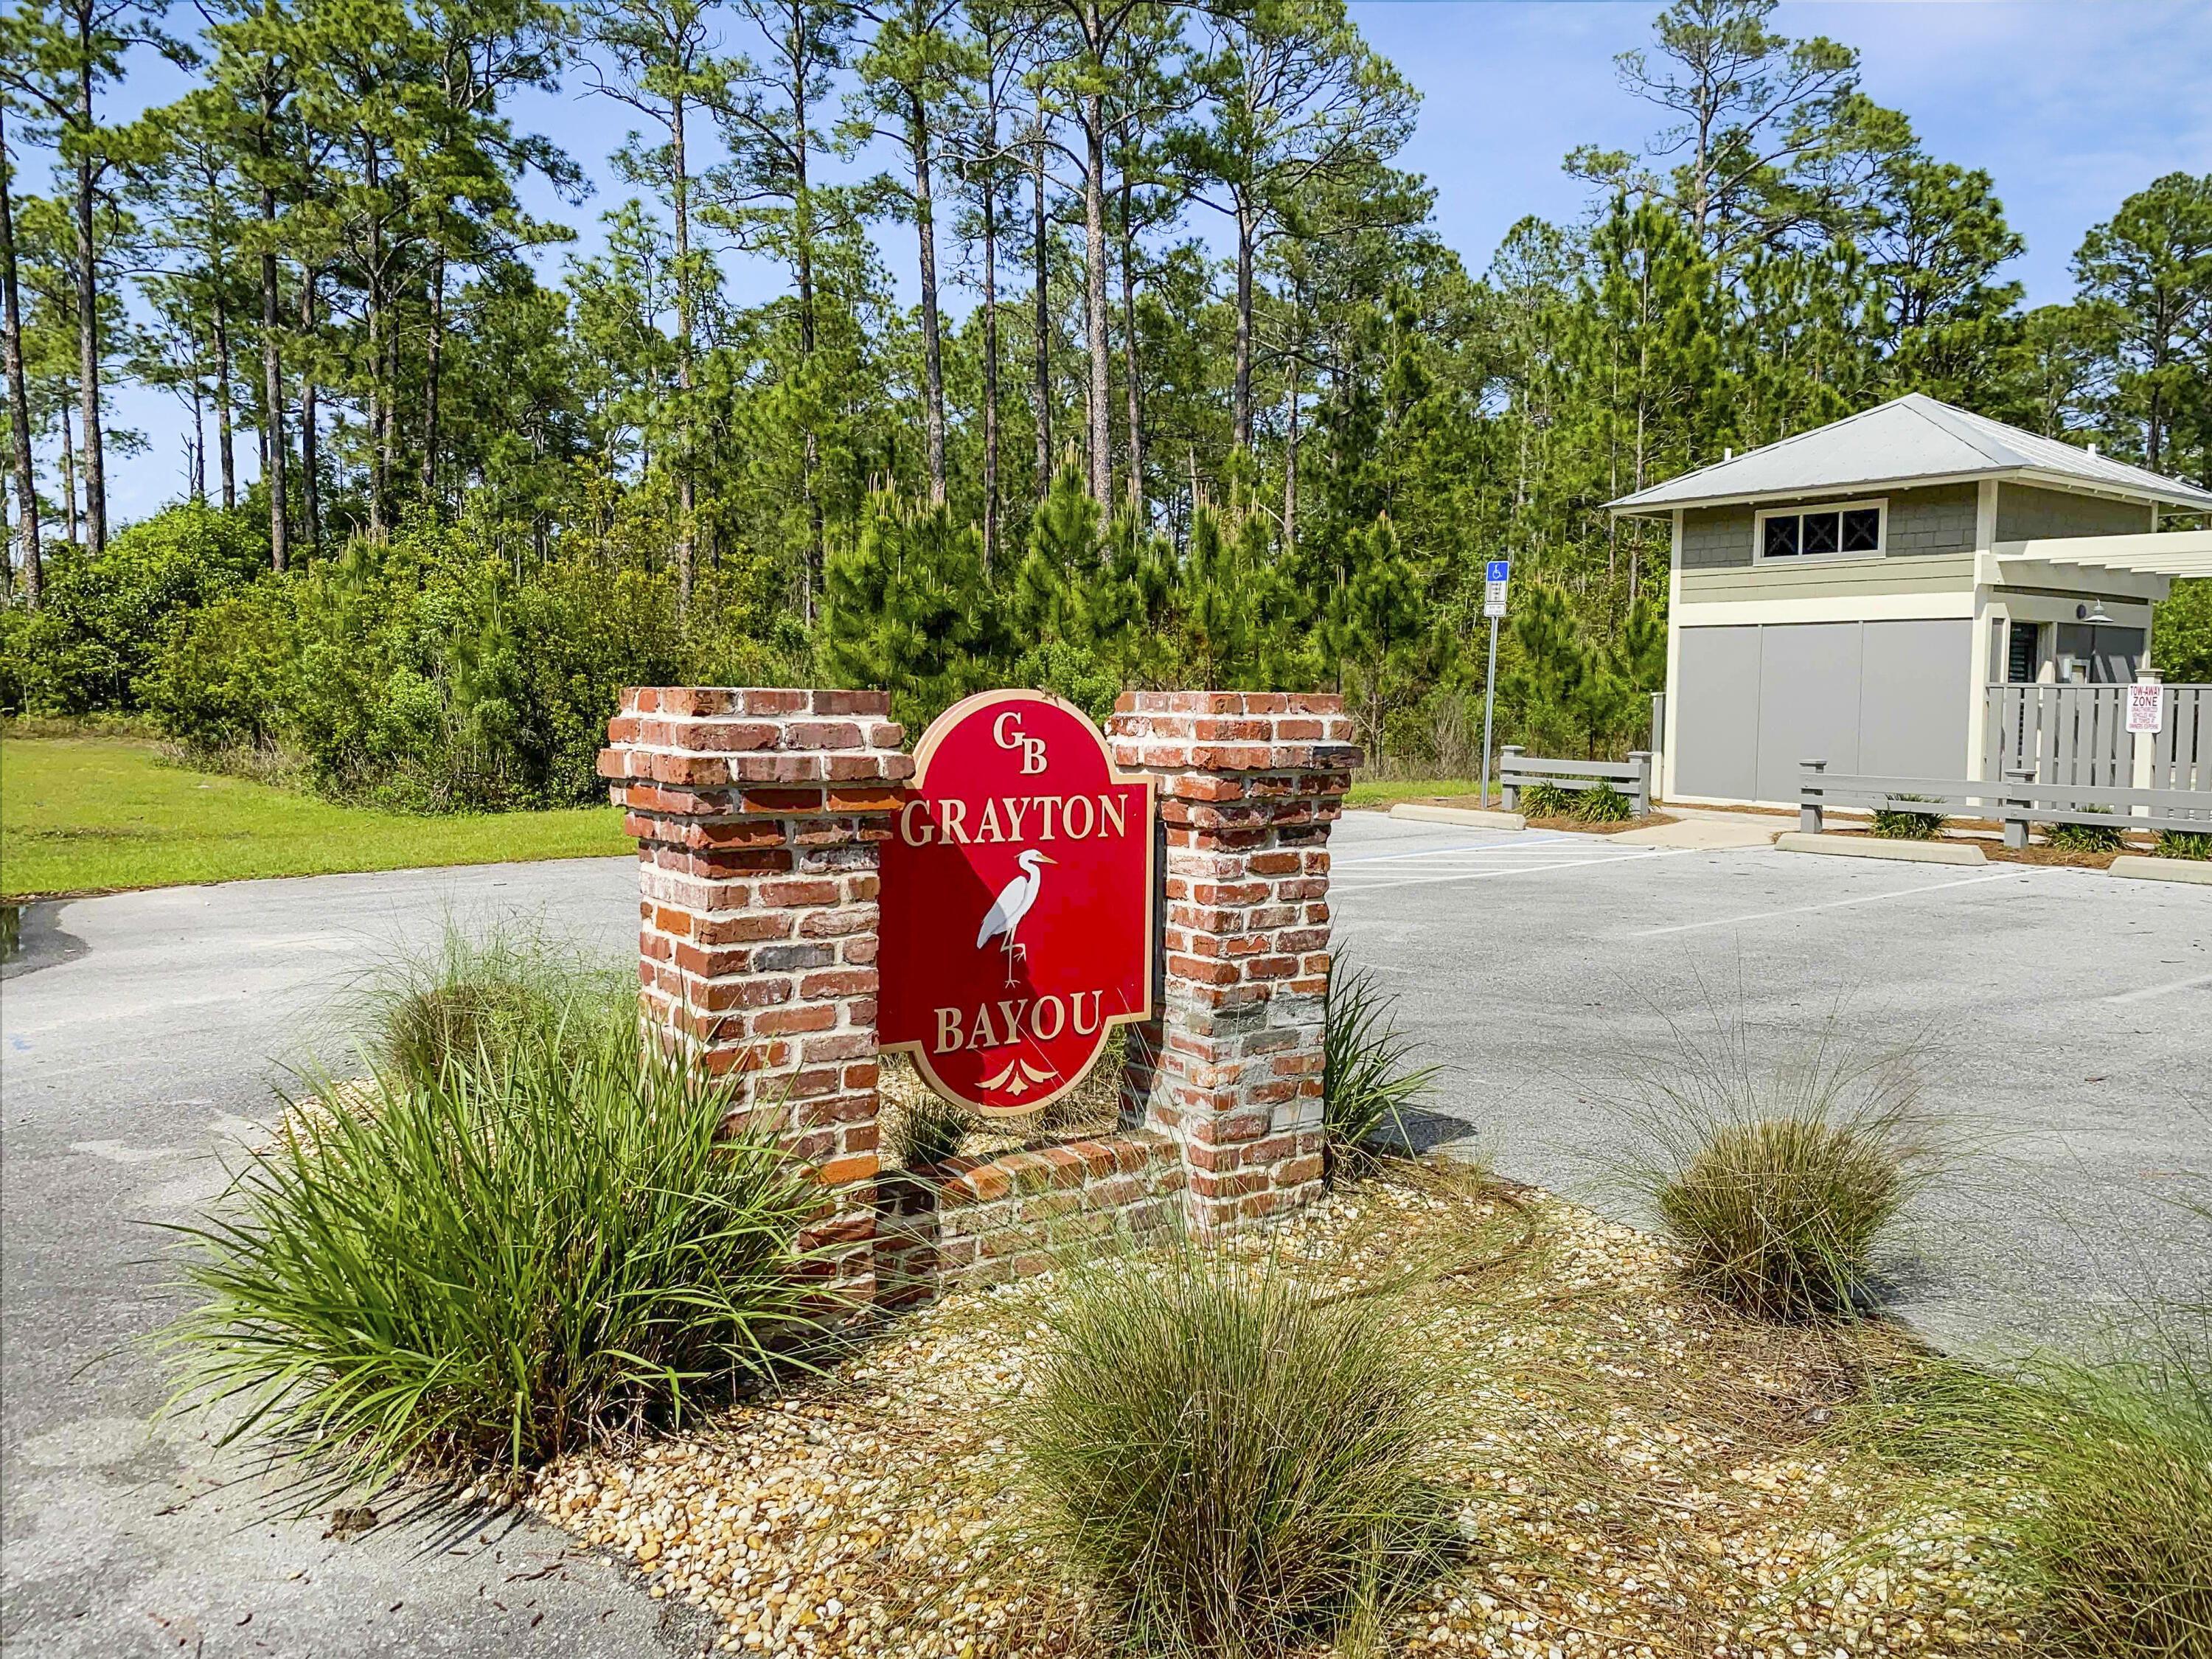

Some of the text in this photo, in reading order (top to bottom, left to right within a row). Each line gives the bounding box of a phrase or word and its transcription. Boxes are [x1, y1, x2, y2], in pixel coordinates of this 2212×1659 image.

[2130, 686, 2160, 696] TOW-AWAY
[2133, 697, 2157, 706] ZONE
[900, 794, 1128, 846] GRAYTON
[933, 990, 1103, 1054] BAYOU
